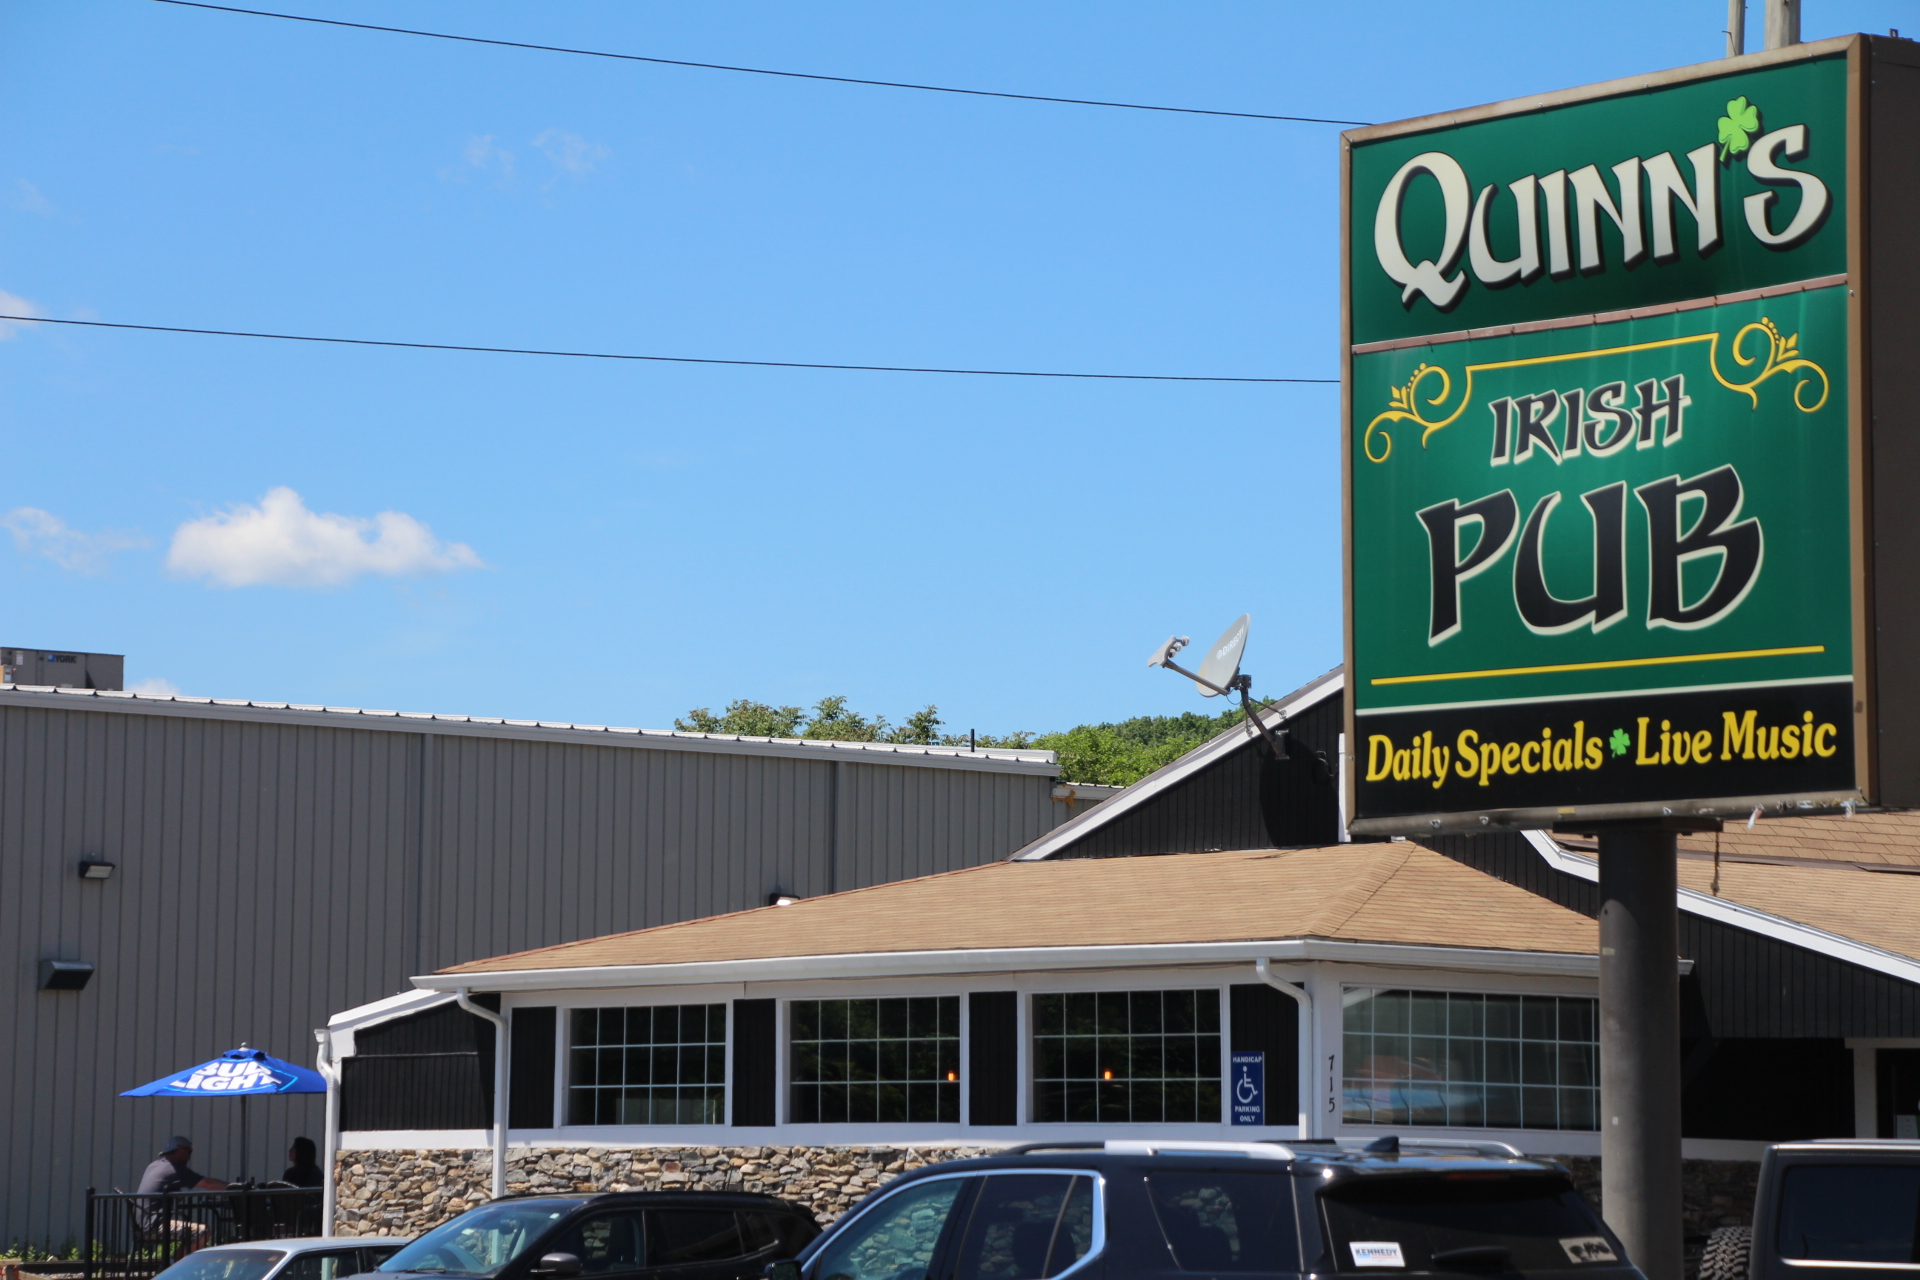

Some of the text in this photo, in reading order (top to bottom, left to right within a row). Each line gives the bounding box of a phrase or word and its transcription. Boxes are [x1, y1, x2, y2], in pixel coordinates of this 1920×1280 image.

[1488, 373, 1692, 466] IRISH
[1415, 463, 1764, 648] PUB
[55, 654, 77, 664] YORK
[1365, 709, 1837, 789] Daily Specials Live Music
[194, 1061, 272, 1076] BUD
[169, 1073, 282, 1091] LIGHT
[1235, 1105, 1260, 1113] PARKING
[1355, 1248, 1398, 1256] KENNEDY
